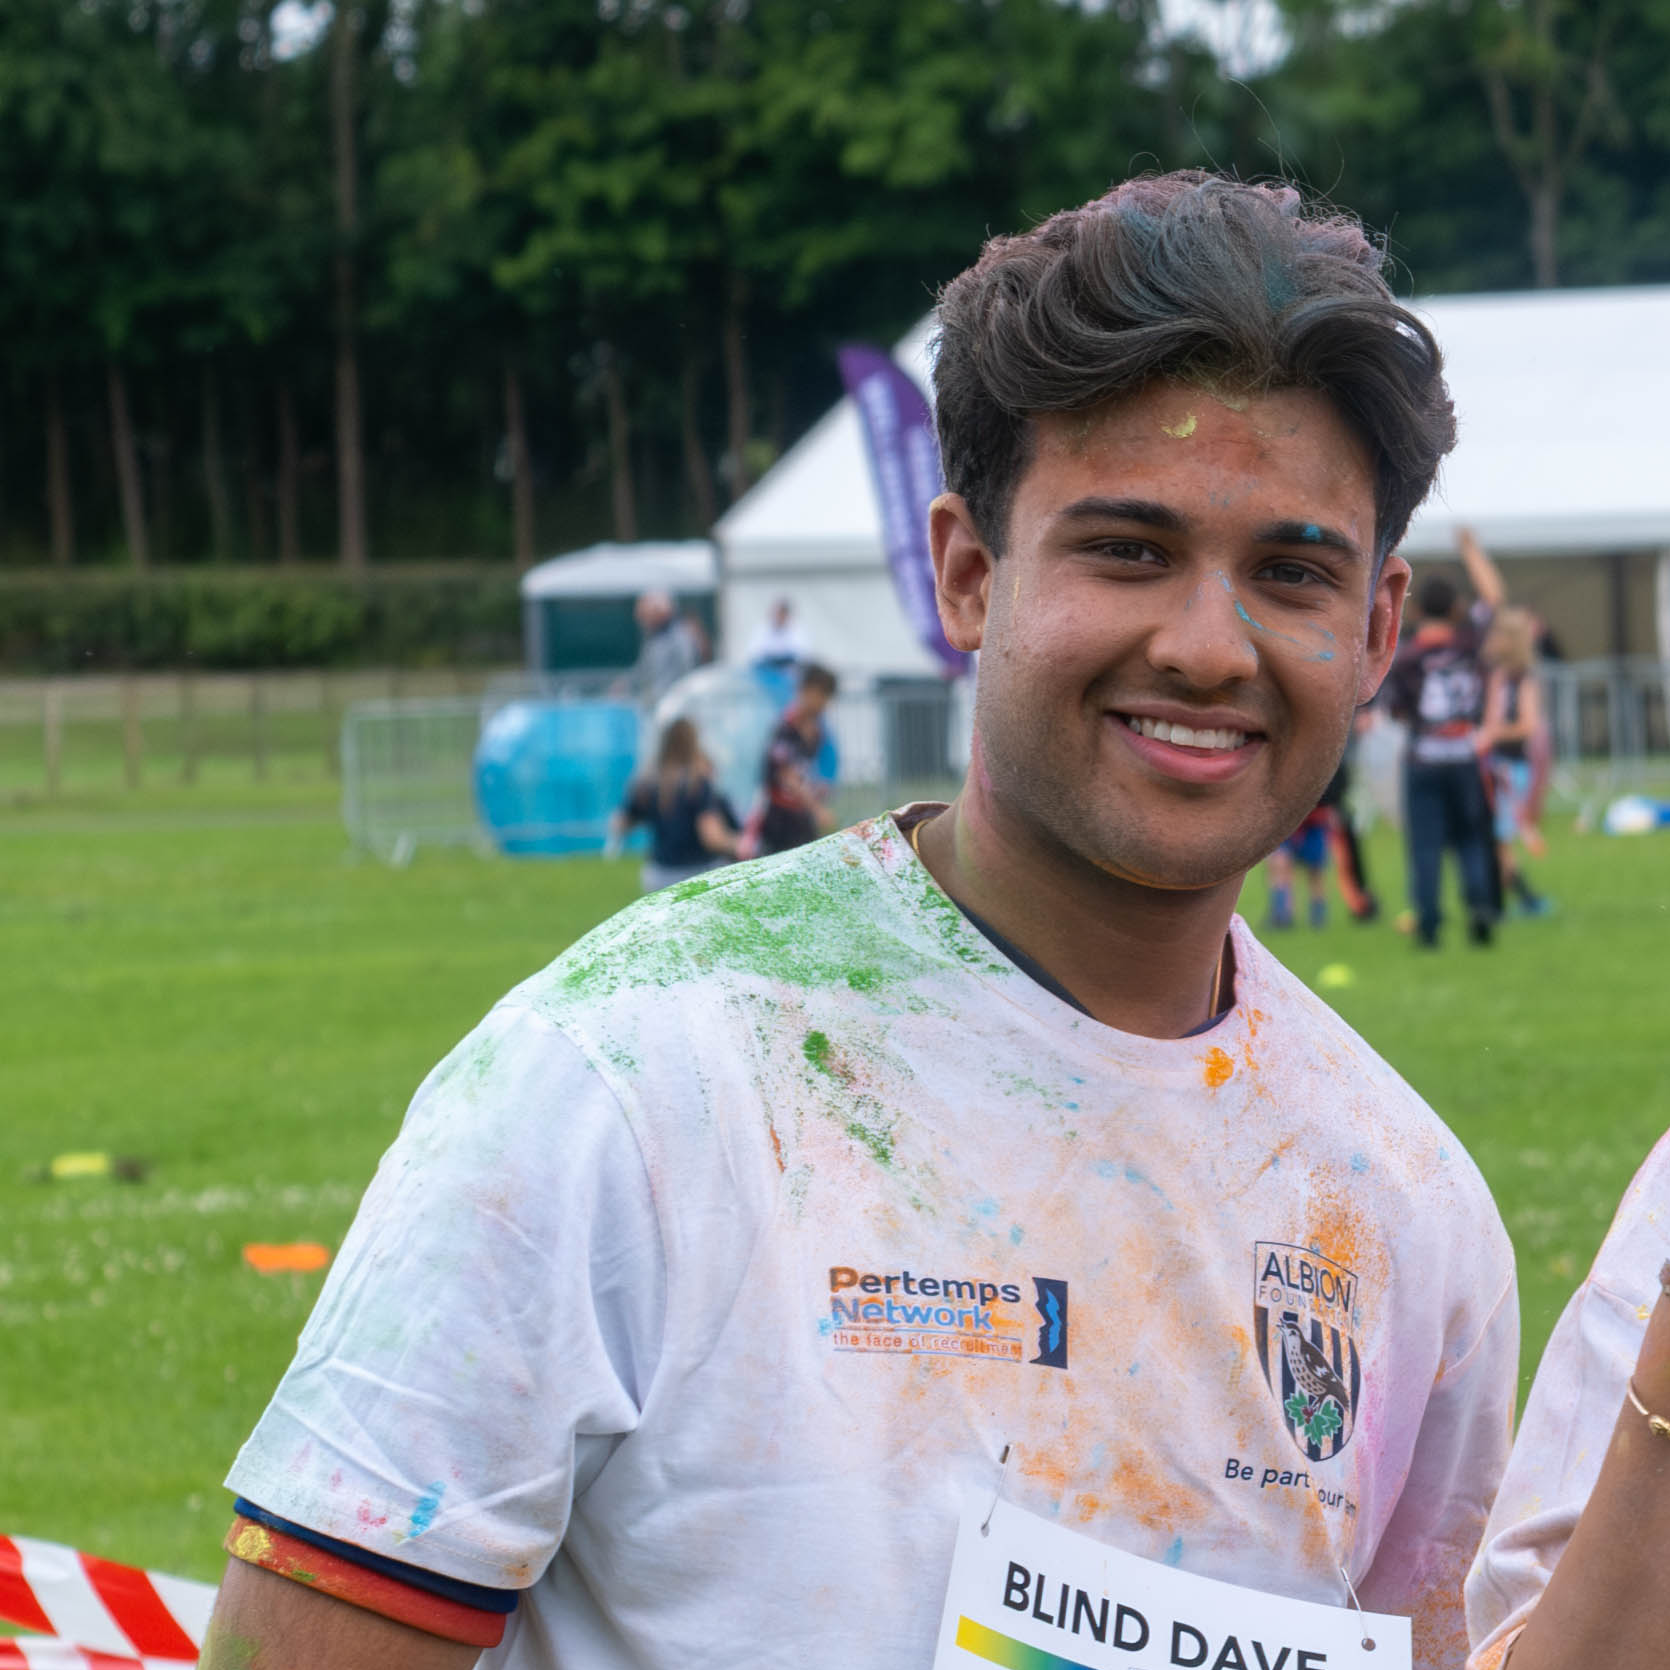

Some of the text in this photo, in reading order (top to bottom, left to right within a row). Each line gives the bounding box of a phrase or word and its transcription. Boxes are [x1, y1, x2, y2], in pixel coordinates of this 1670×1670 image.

[829, 1266, 1022, 1306] Pertemps
[1261, 1251, 1351, 1312] ALBION
[830, 1295, 993, 1331] Network
[833, 1333, 859, 1346] the
[866, 1334, 902, 1348] face
[1225, 1458, 1310, 1489] Be part
[1318, 1488, 1344, 1508] our
[1003, 1560, 1150, 1652] BLIND
